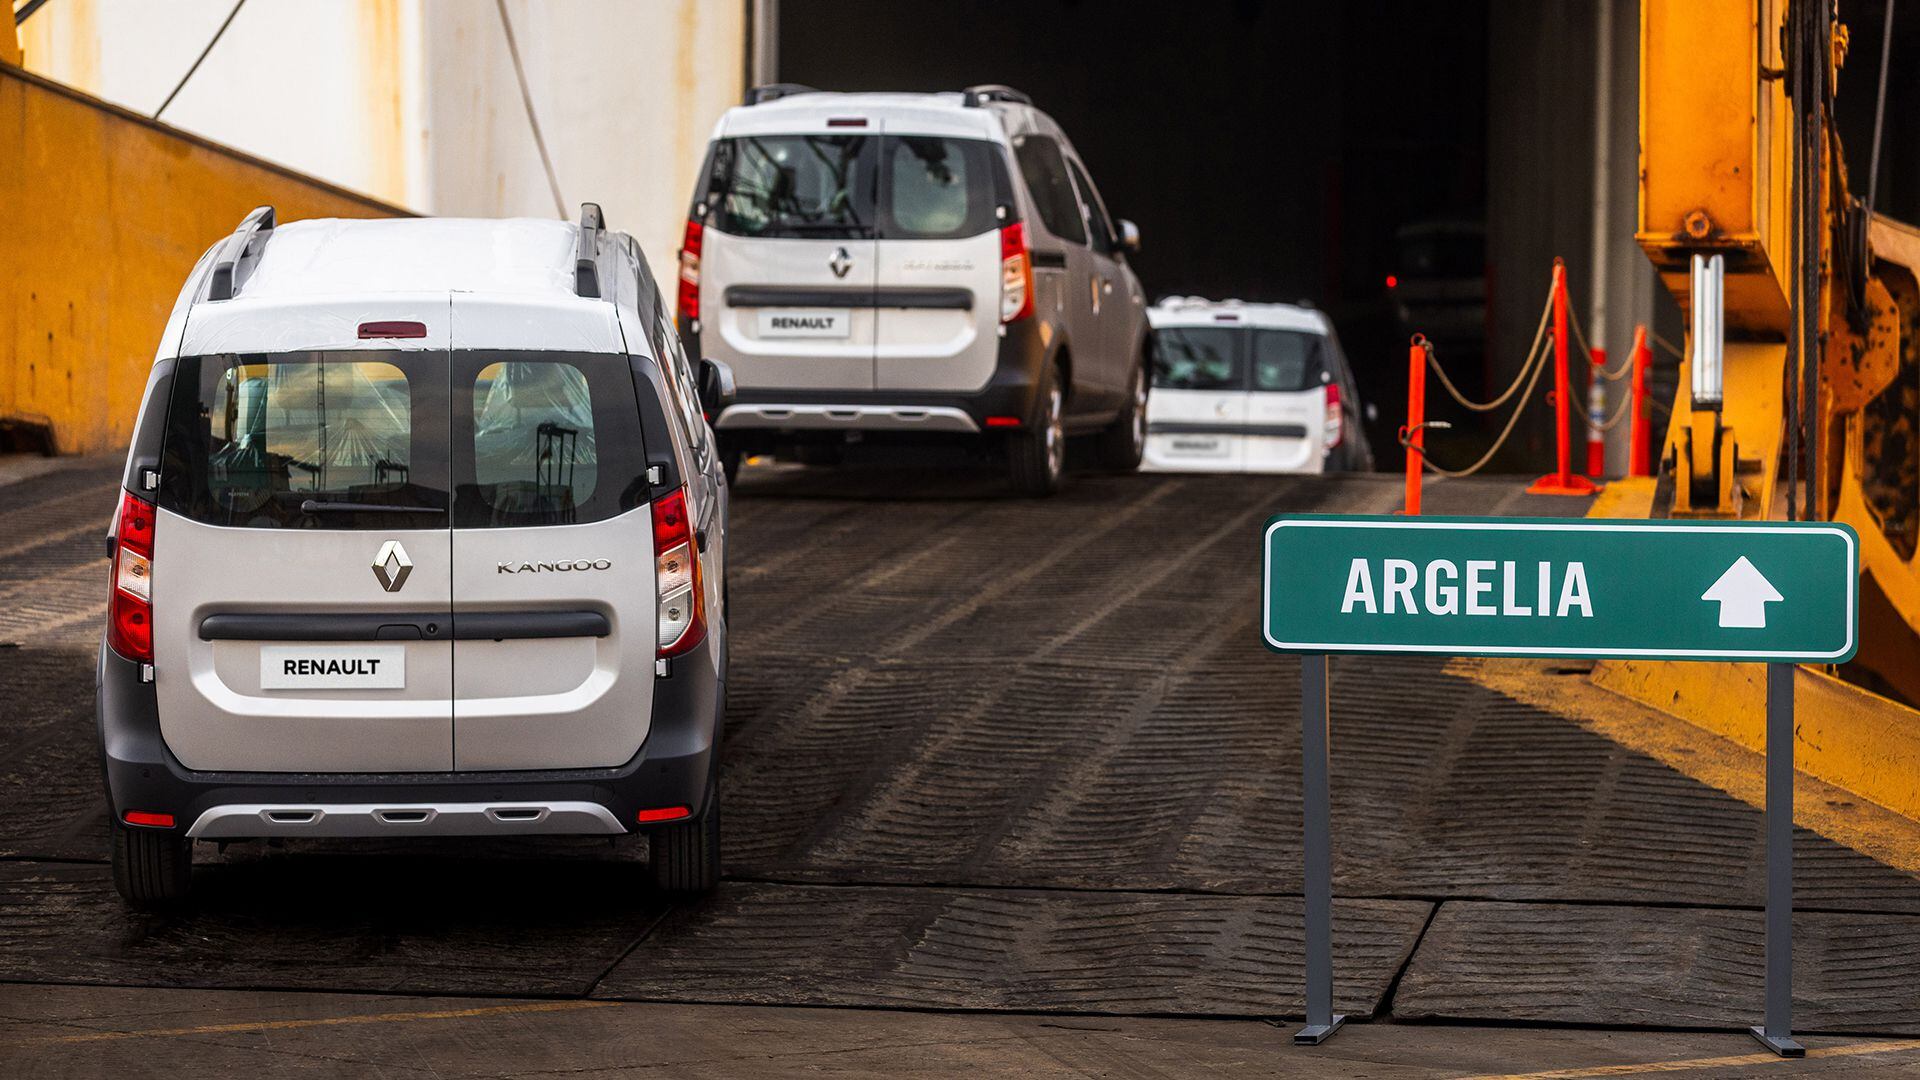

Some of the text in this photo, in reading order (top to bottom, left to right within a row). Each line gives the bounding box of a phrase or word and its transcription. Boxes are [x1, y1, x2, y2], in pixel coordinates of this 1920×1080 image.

[771, 317, 834, 329] RENAULT
[497, 558, 612, 575] KANGOO
[1340, 558, 1594, 617] ARGELIA
[283, 659, 381, 676] RENAULT
